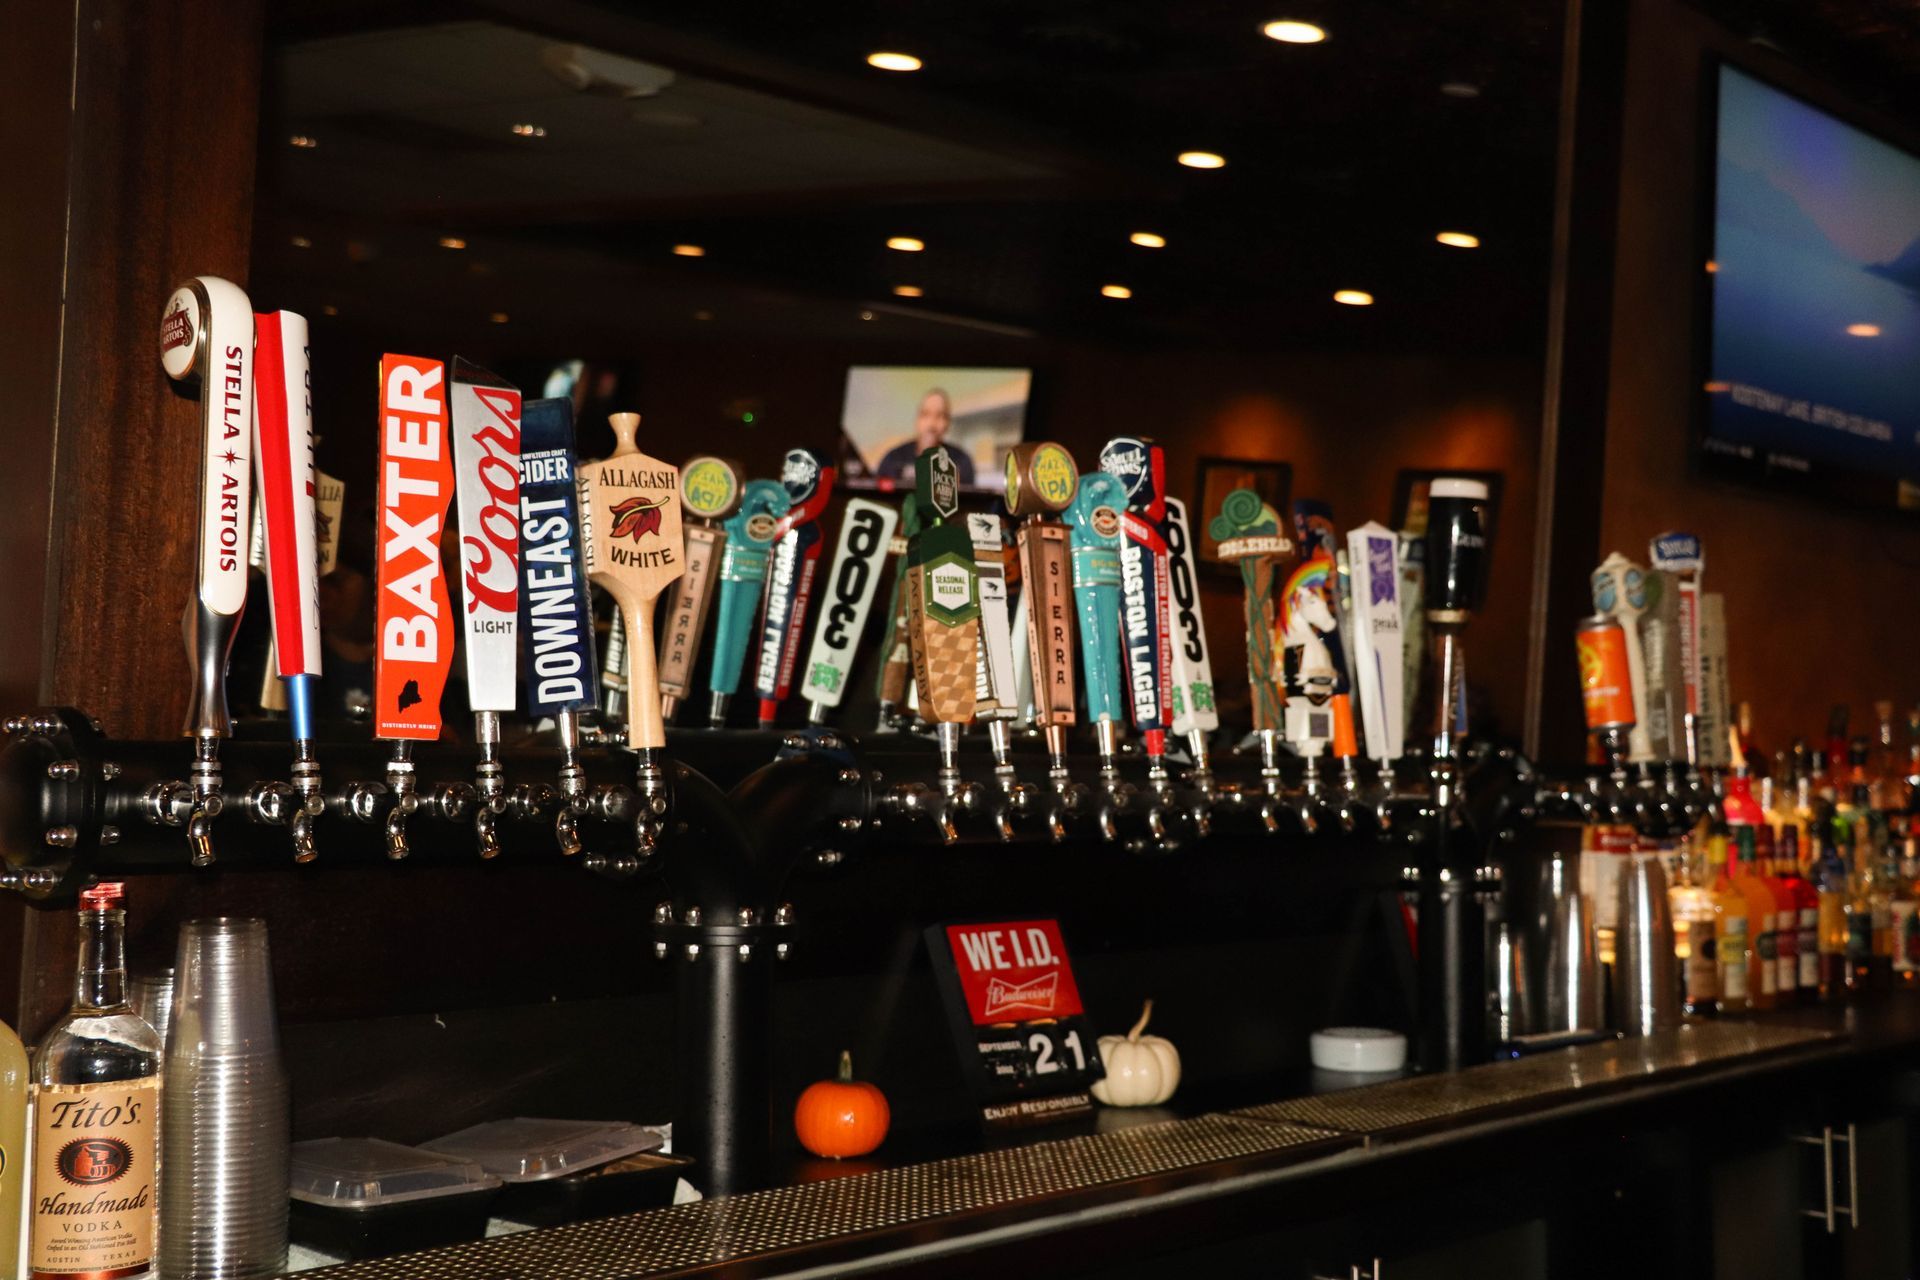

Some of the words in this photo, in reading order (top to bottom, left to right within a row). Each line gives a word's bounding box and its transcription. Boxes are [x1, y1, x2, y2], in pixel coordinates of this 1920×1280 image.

[223, 345, 243, 441] STELLA
[519, 456, 569, 485] CIDER
[600, 467, 676, 490] ALLAGASH
[383, 364, 443, 664] BAXTER
[463, 386, 521, 614] Coors
[219, 473, 239, 572] ARTOIS
[611, 546, 675, 569] WHITE
[935, 575, 966, 584] SEASONAL
[938, 585, 964, 594] RELEASE
[1120, 546, 1148, 639] BOSTON
[521, 495, 584, 703] DOWNEAST
[474, 620, 513, 634] LIGHT
[1050, 561, 1066, 685] SIERRA
[1130, 645, 1157, 722] LAGER
[960, 930, 1011, 972] WE
[1009, 928, 1060, 969] I.D.
[986, 985, 1054, 1005] Budweiser
[51, 1096, 141, 1129] Tito's
[39, 1185, 149, 1216] Handmade
[62, 1221, 123, 1233] VODKA
[46, 1256, 81, 1264] AUSTIN
[102, 1250, 137, 1261] TEXAS
